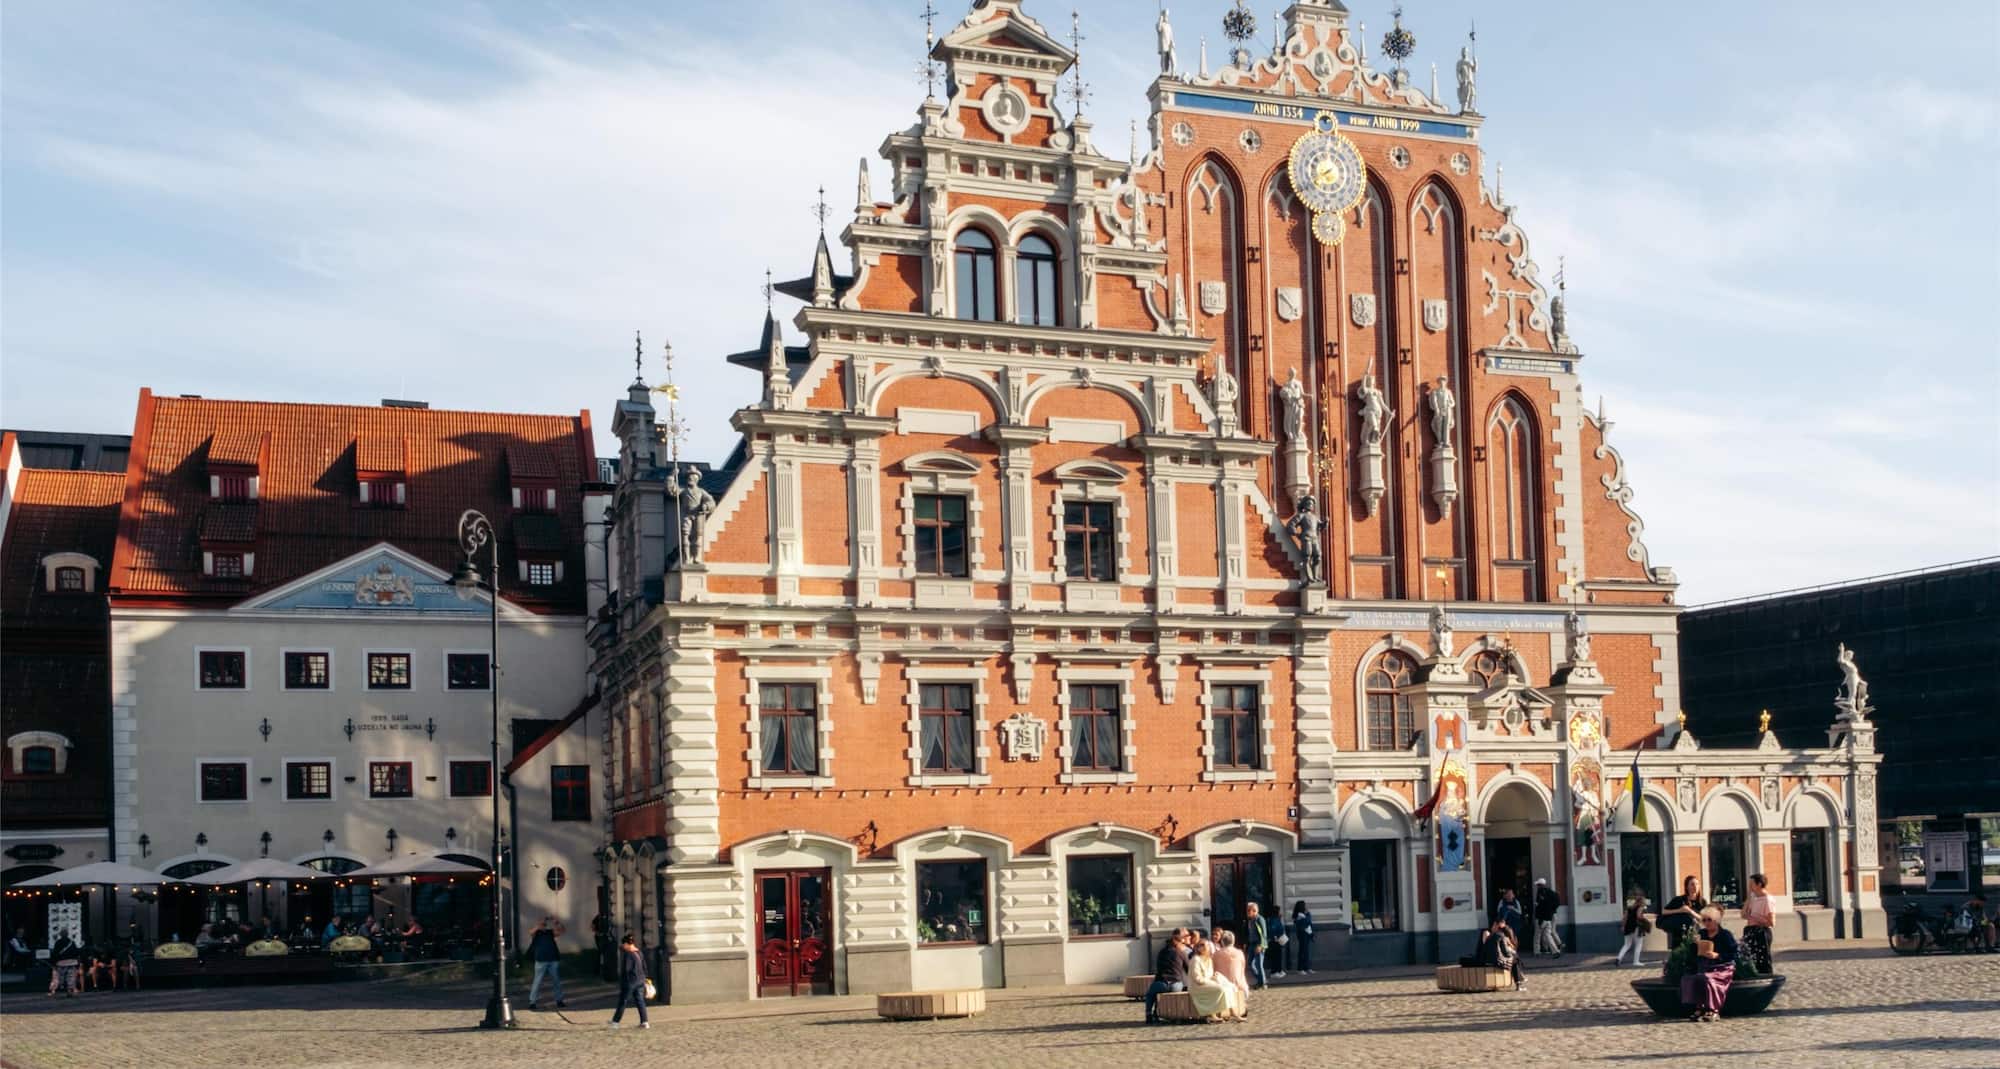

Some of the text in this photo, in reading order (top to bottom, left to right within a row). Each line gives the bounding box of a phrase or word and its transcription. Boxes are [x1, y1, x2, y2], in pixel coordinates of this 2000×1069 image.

[1253, 102, 1279, 116] ANNO
[1373, 115, 1397, 129] ANNO
[1400, 119, 1420, 131] 1999
